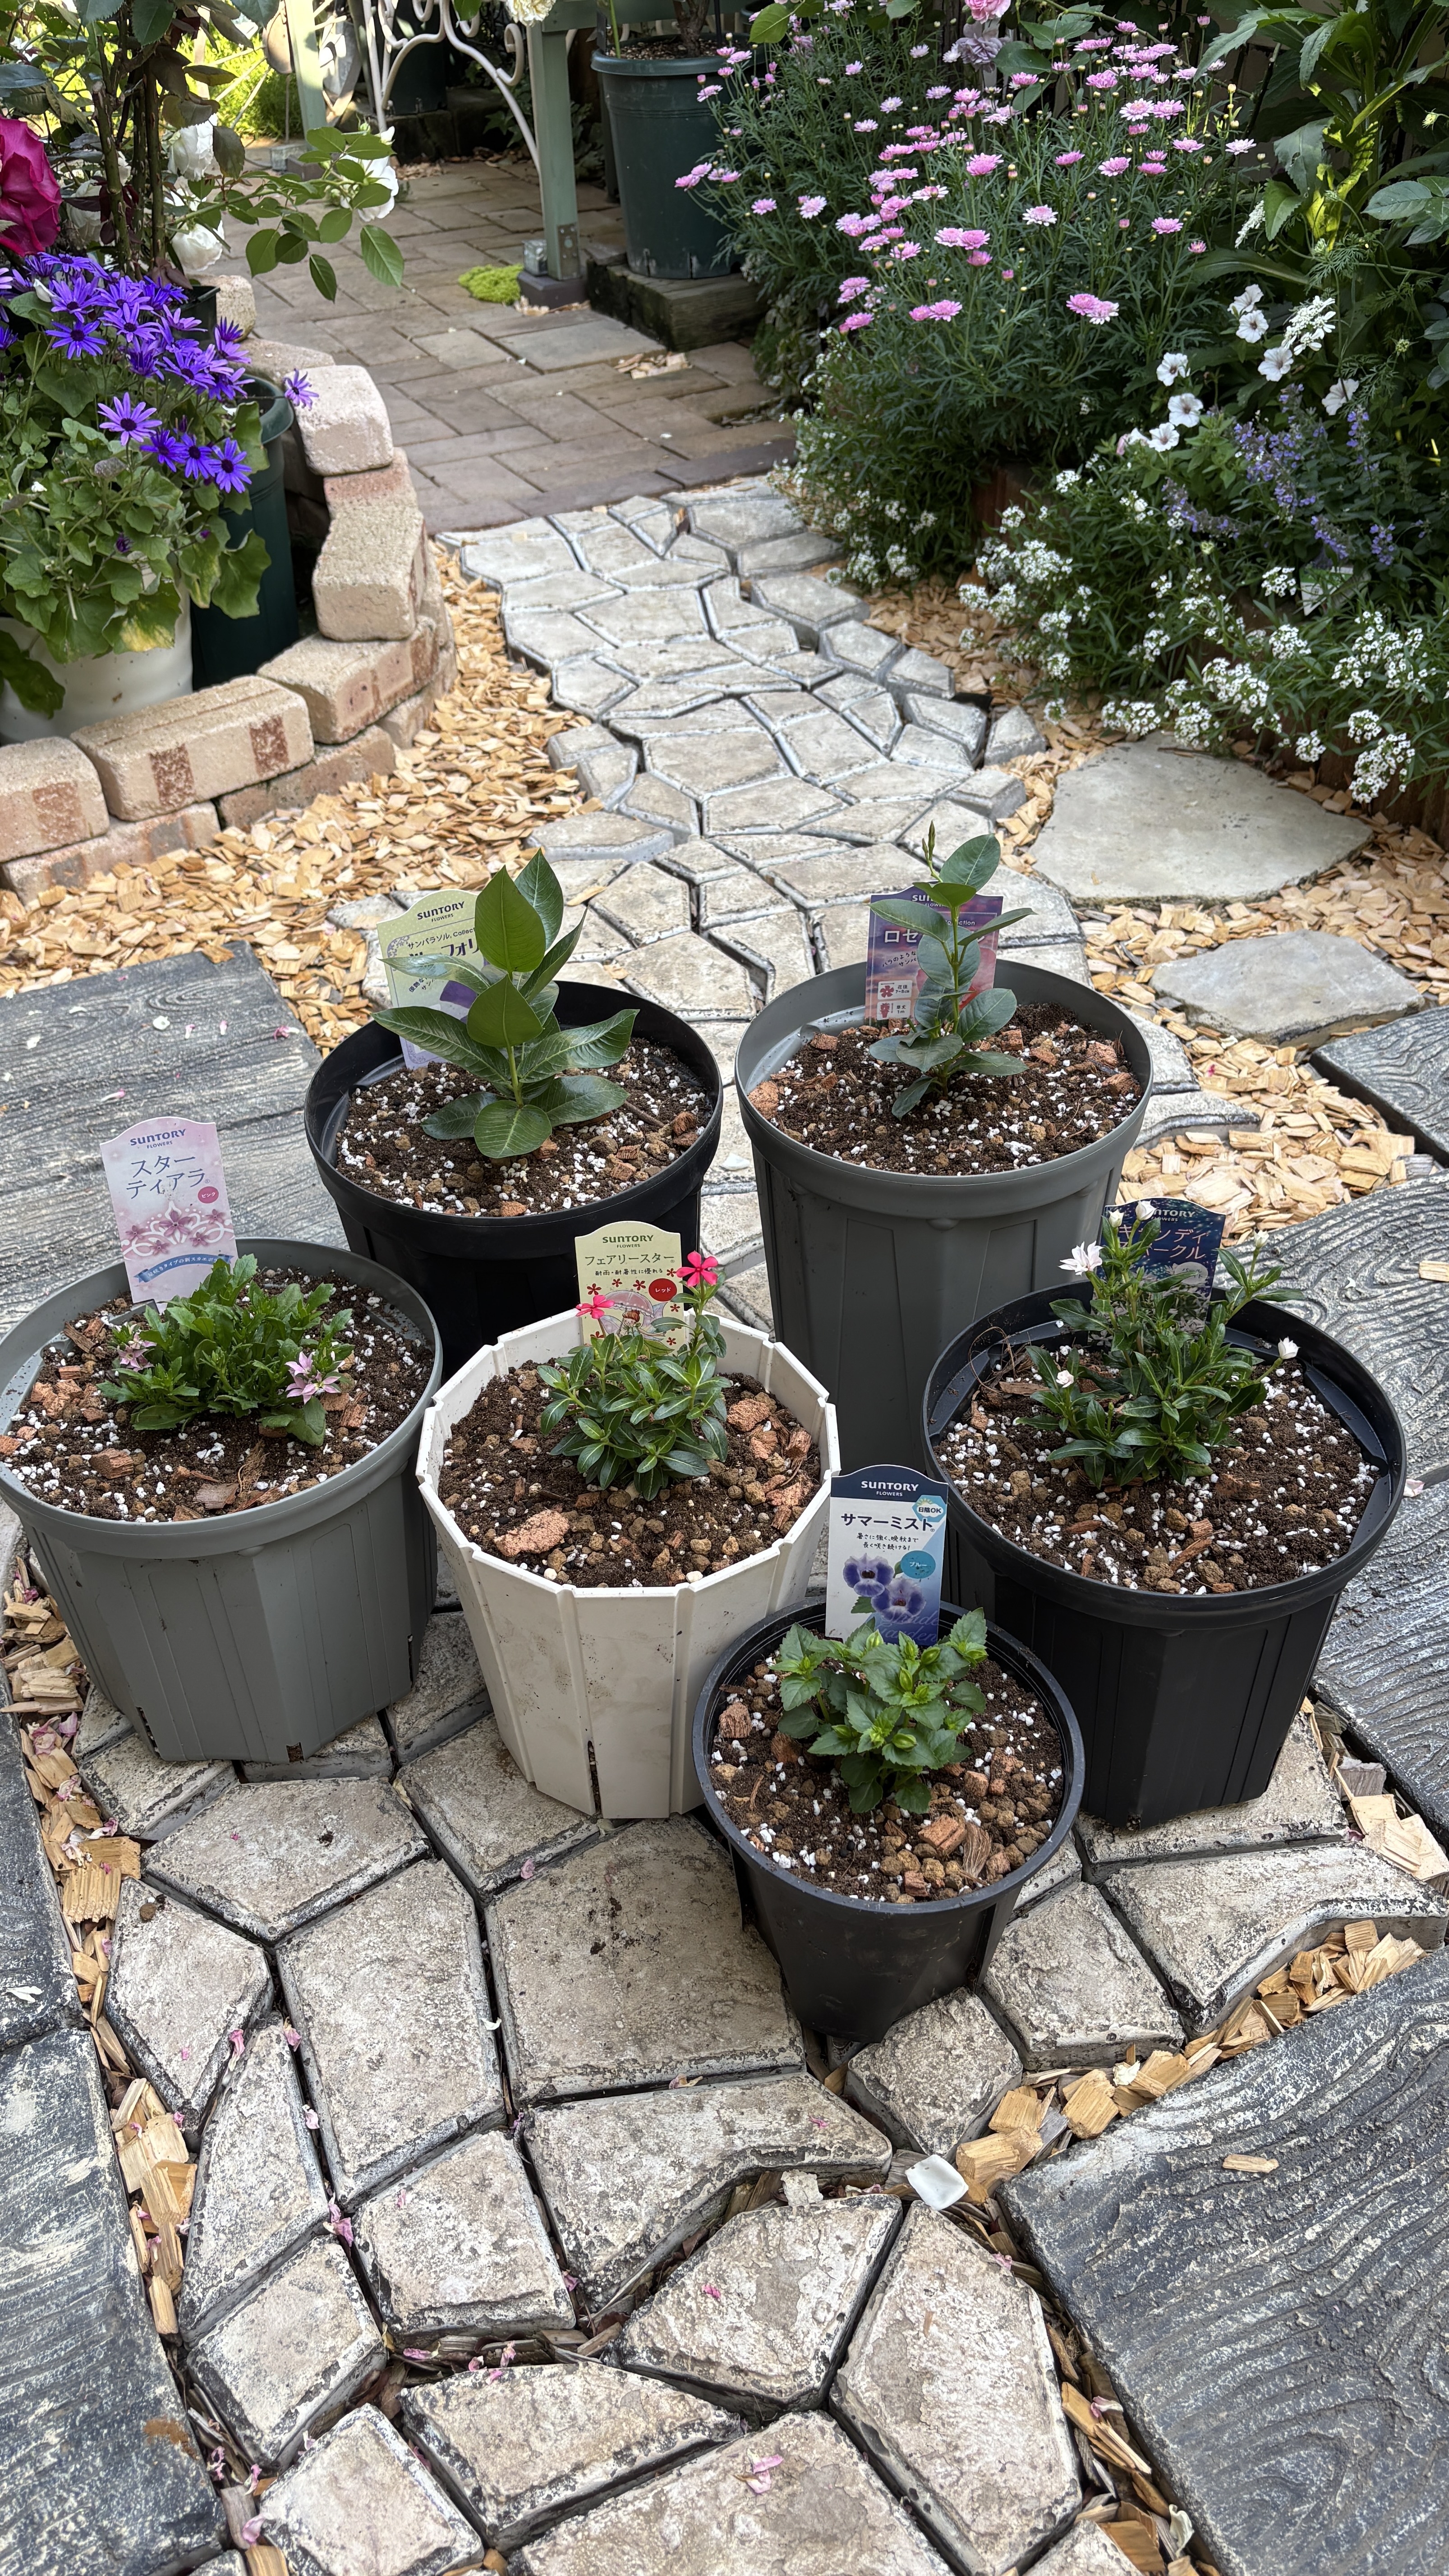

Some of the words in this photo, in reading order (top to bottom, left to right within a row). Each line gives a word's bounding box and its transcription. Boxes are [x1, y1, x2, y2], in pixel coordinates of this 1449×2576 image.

[417, 901, 465, 920] SUNTORY
[431, 913, 454, 922] FLOWERS
[408, 933, 450, 949] サンパラソル
[130, 1129, 186, 1146] SUNTORY
[147, 1140, 173, 1149] FLOWERS
[131, 1155, 196, 1178] スター
[126, 1168, 206, 1199] ティアラ
[1153, 1209, 1196, 1217] NTORY
[602, 1235, 653, 1243] SUNTORY
[1119, 1224, 1206, 1244] キンディ
[585, 1253, 674, 1266] フェアリースター
[861, 1481, 919, 1491] SUNTORY
[841, 1513, 933, 1531] サマーミスト
